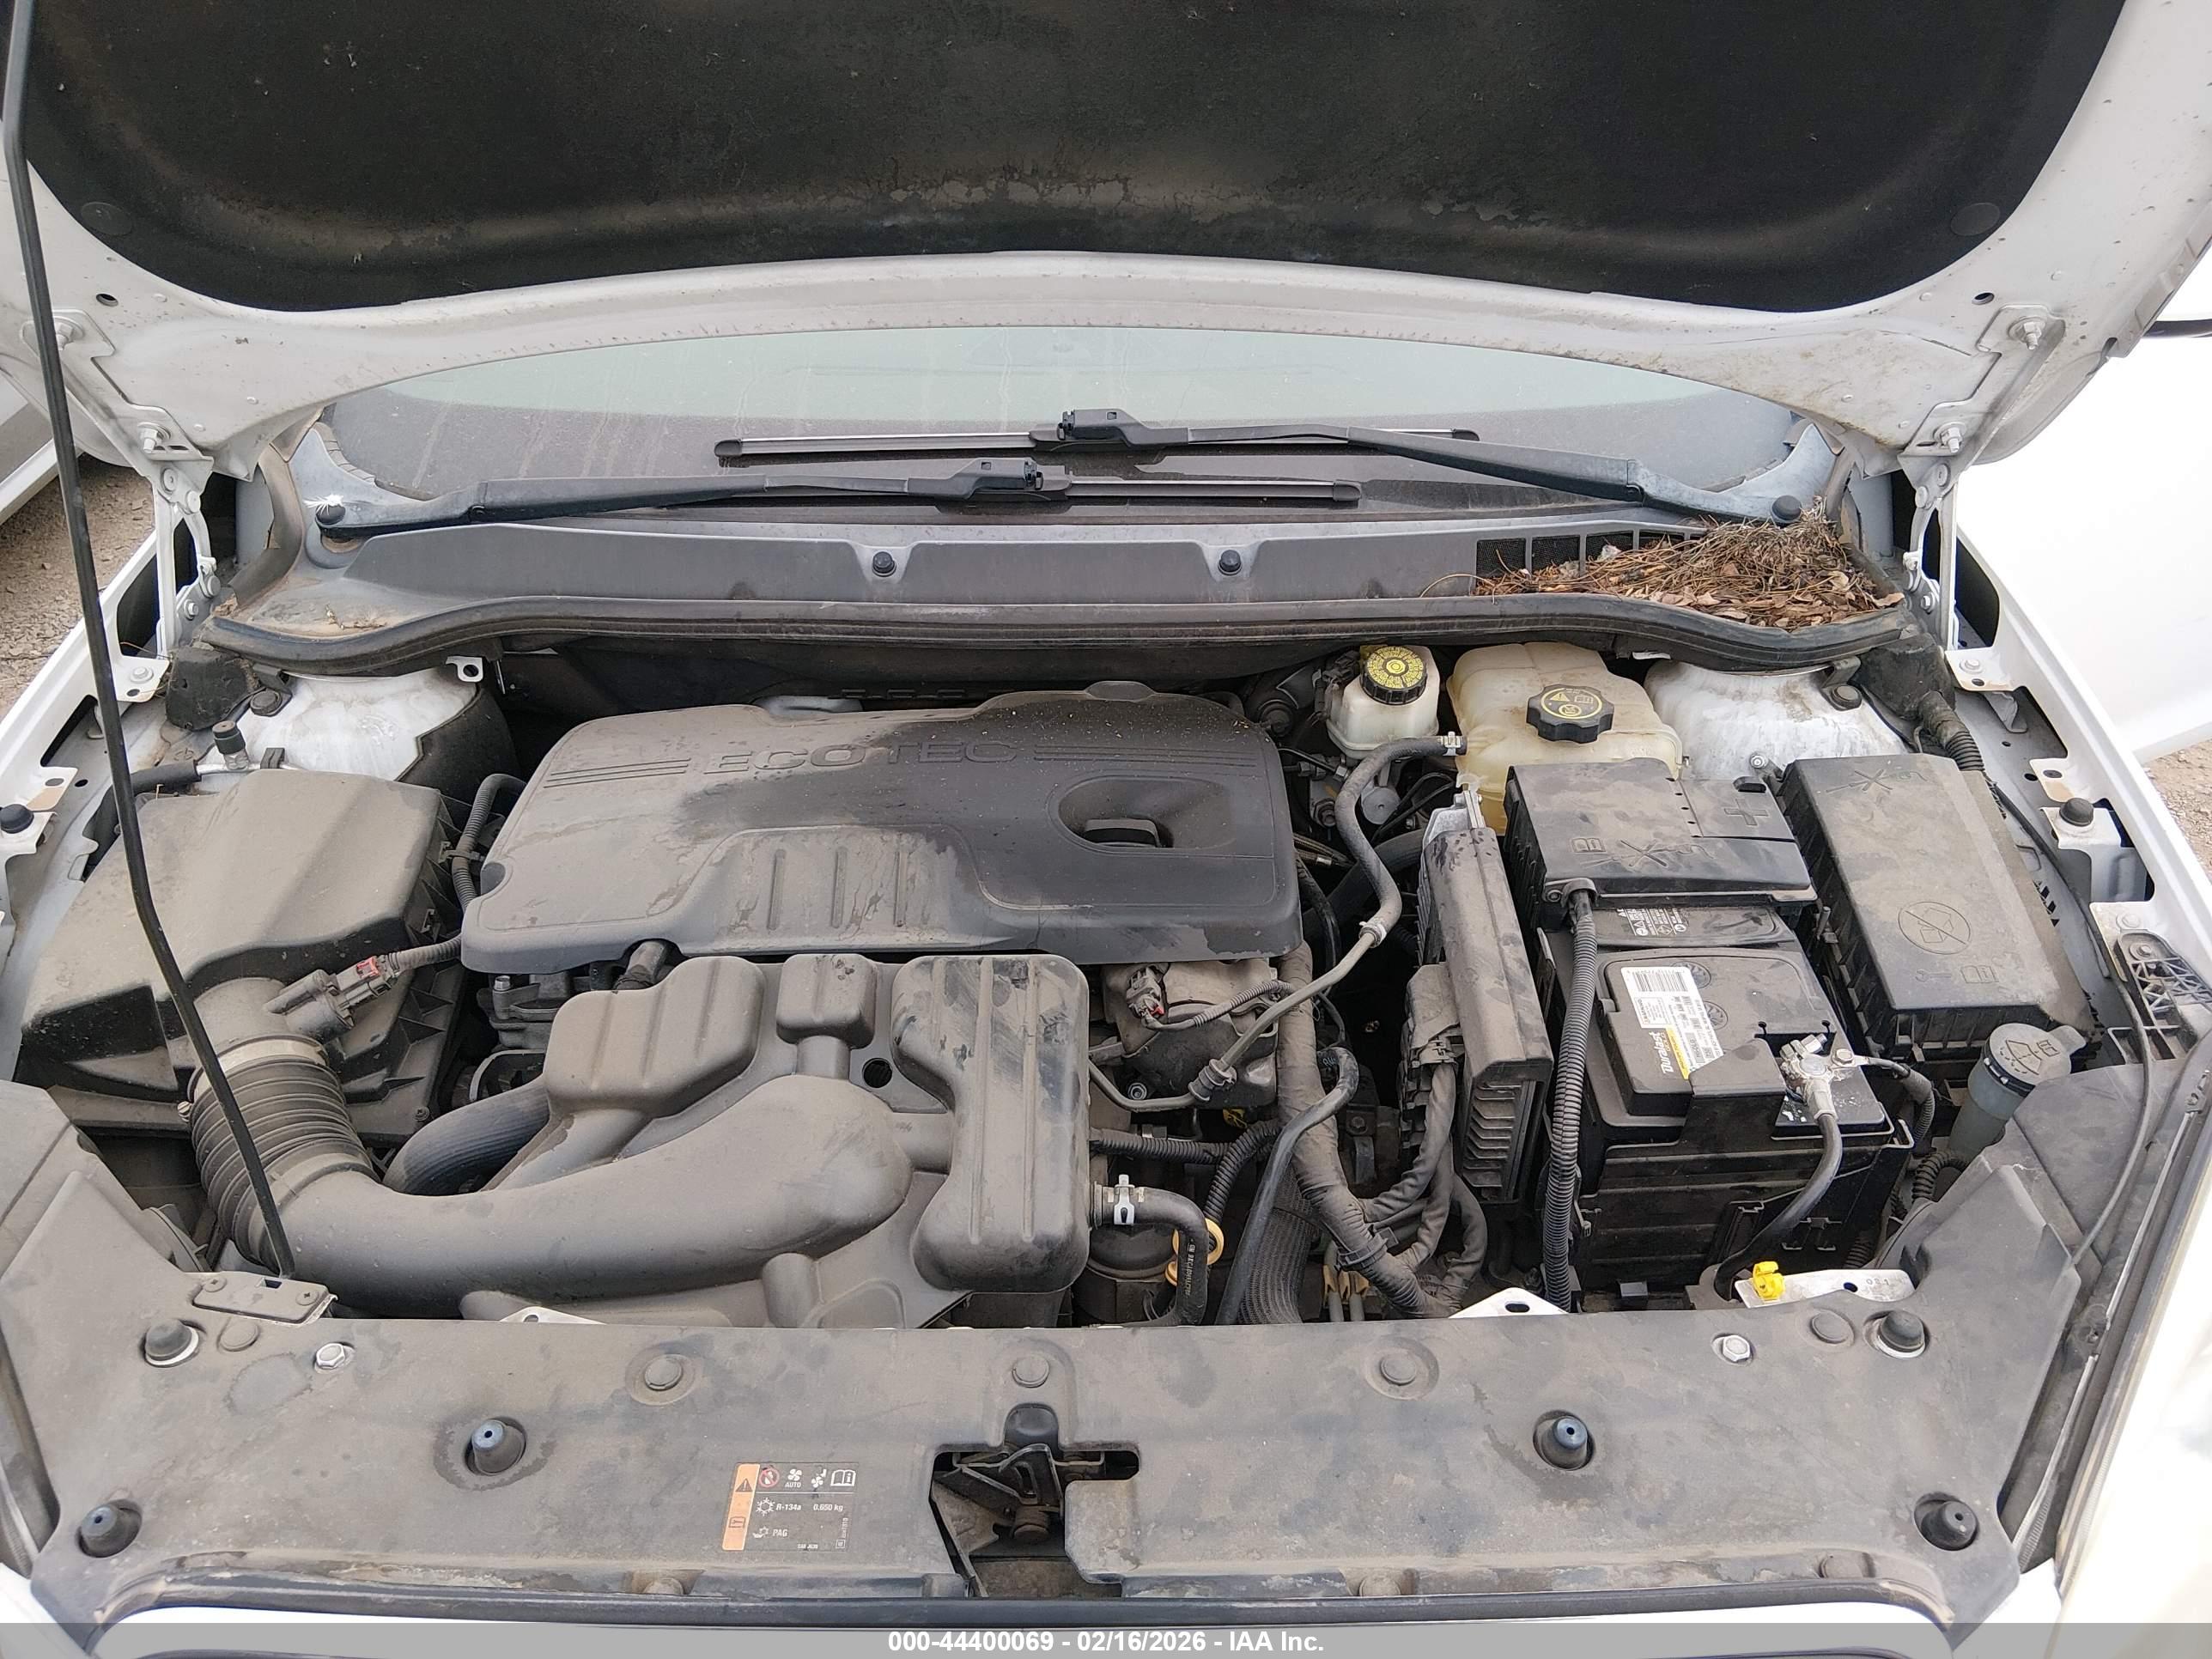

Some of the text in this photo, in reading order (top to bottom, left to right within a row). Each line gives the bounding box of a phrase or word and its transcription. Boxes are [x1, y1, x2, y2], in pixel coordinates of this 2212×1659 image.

[703, 741, 1018, 775] ECOTEC
[1649, 1030, 1674, 1073] Duralast
[773, 1528, 788, 1538] PAG
